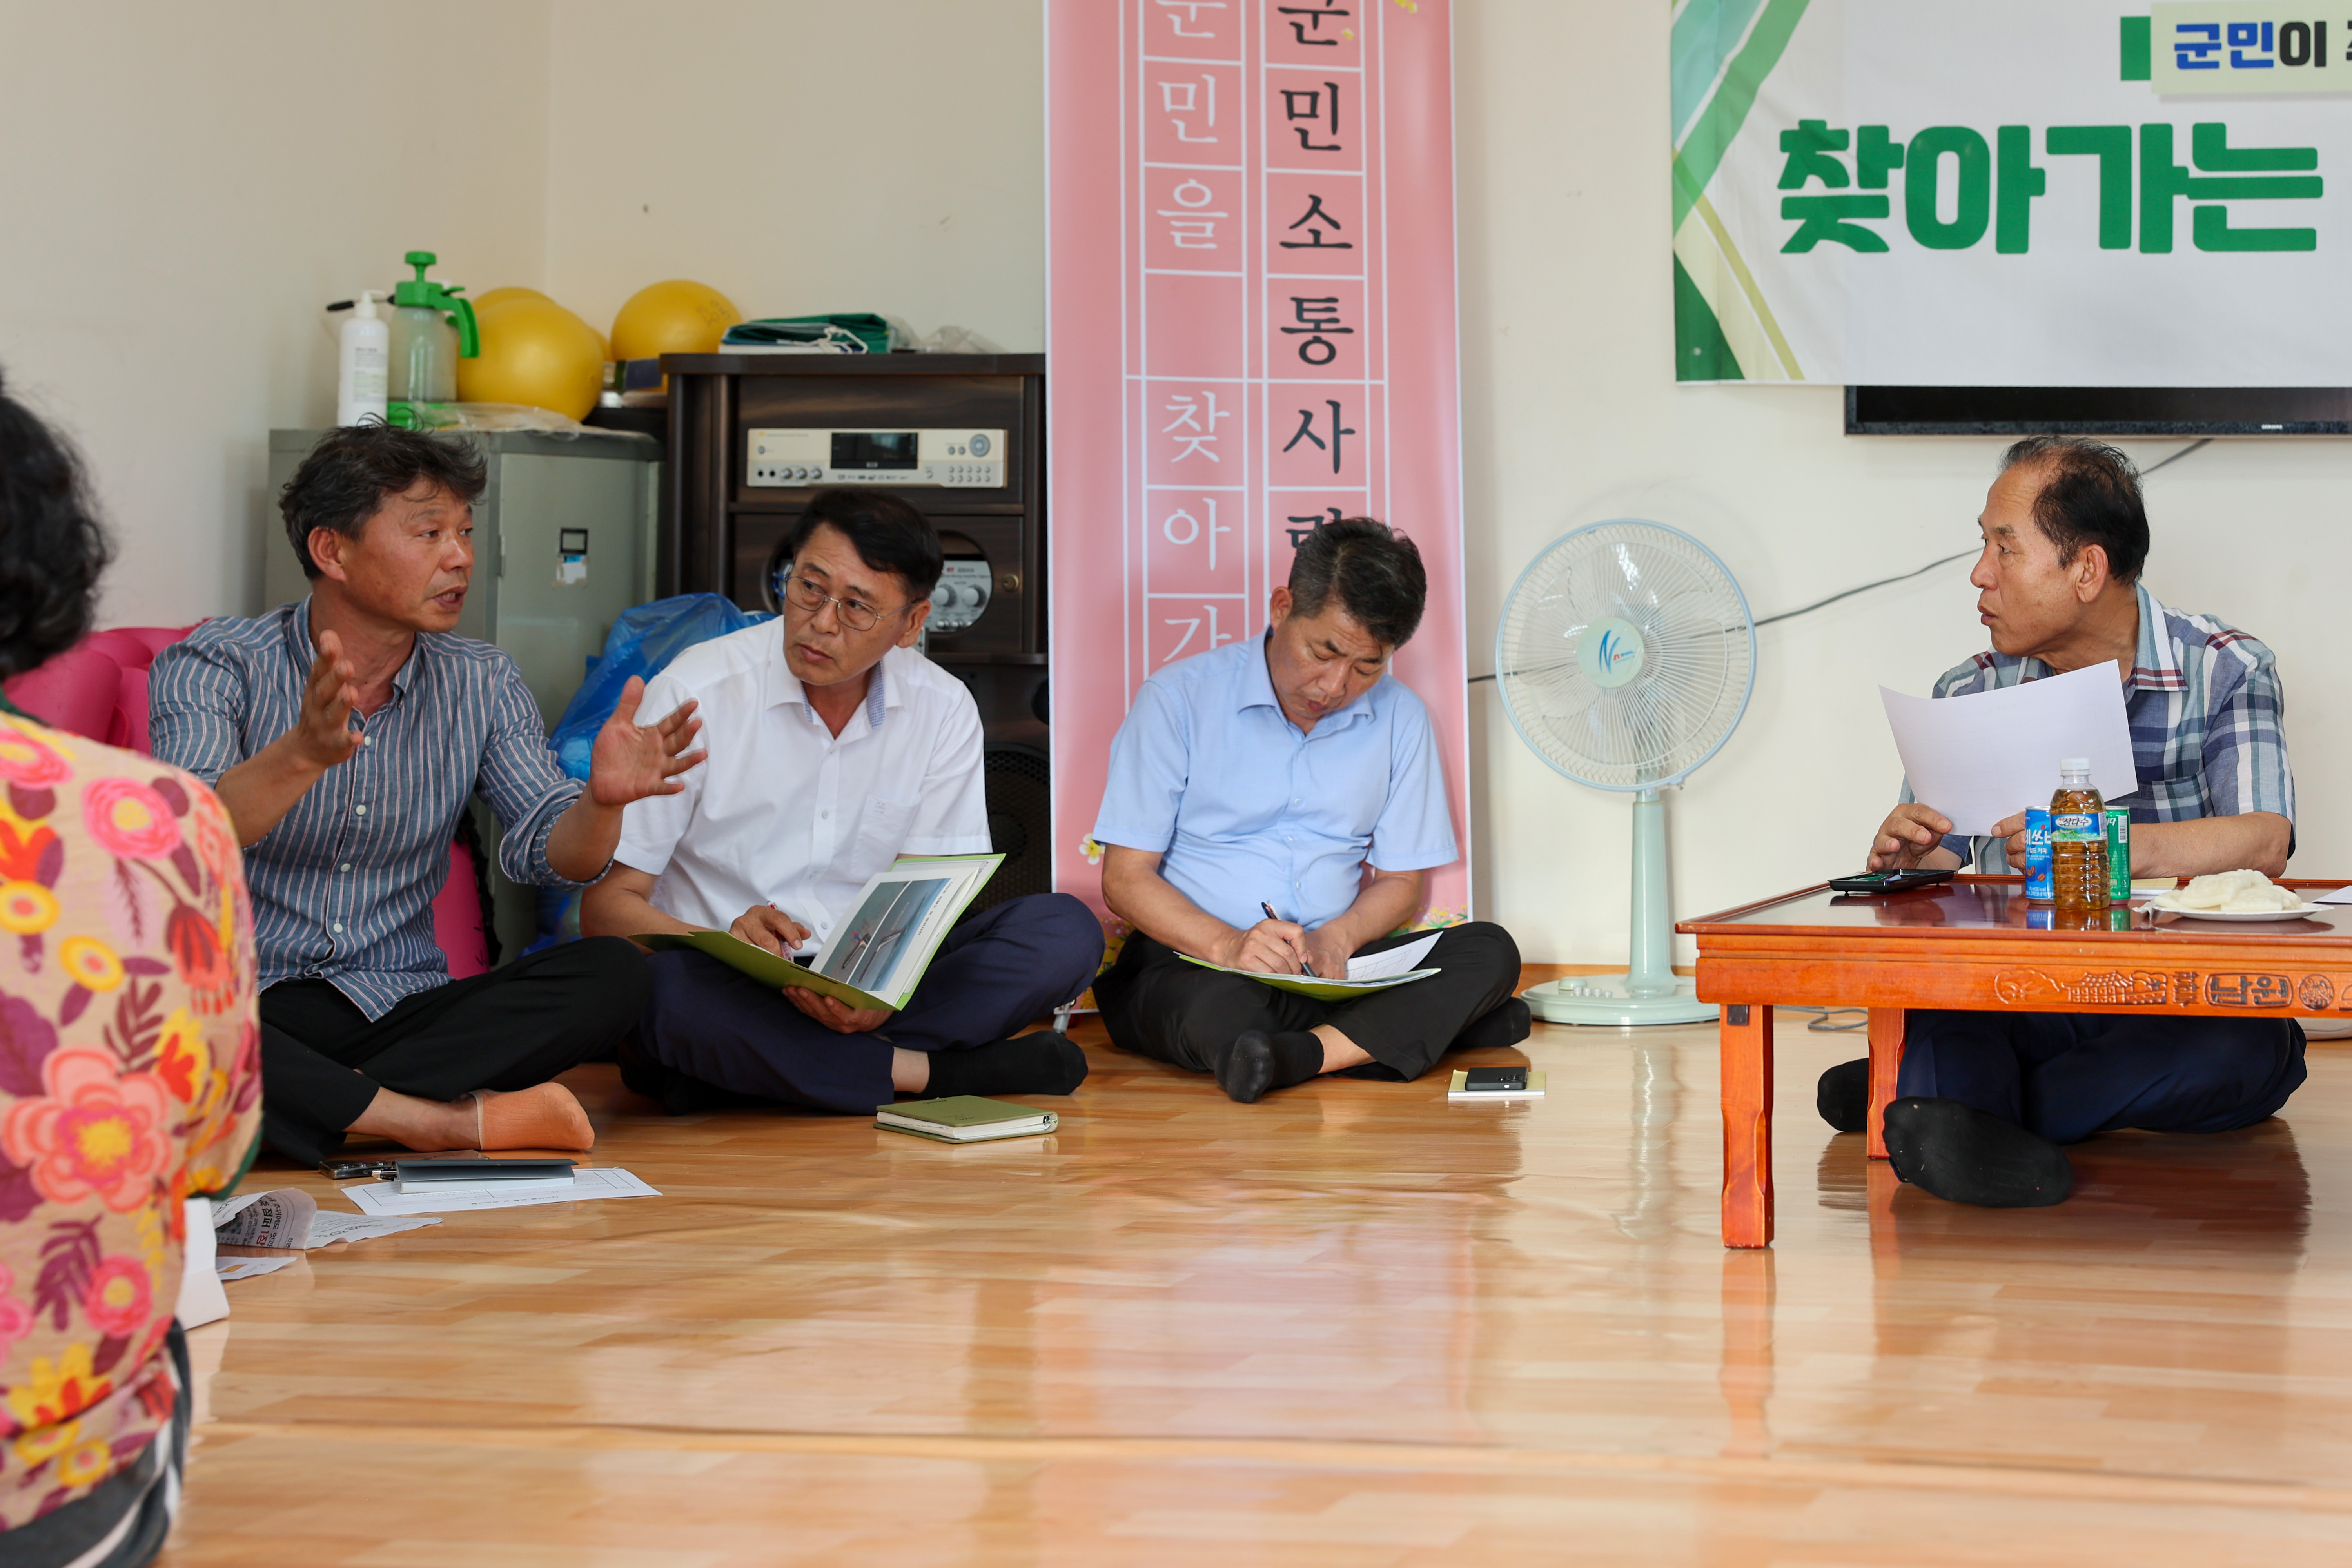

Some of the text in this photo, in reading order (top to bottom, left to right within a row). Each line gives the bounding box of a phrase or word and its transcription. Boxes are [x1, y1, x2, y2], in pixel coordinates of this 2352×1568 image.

[2174, 20, 2326, 69] 군민이
[1777, 119, 2323, 254] 찾아가는
[2063, 817, 2089, 827] 삼다수
[2210, 976, 2288, 1005] 남원
[261, 1208, 273, 1228] 점퍼
